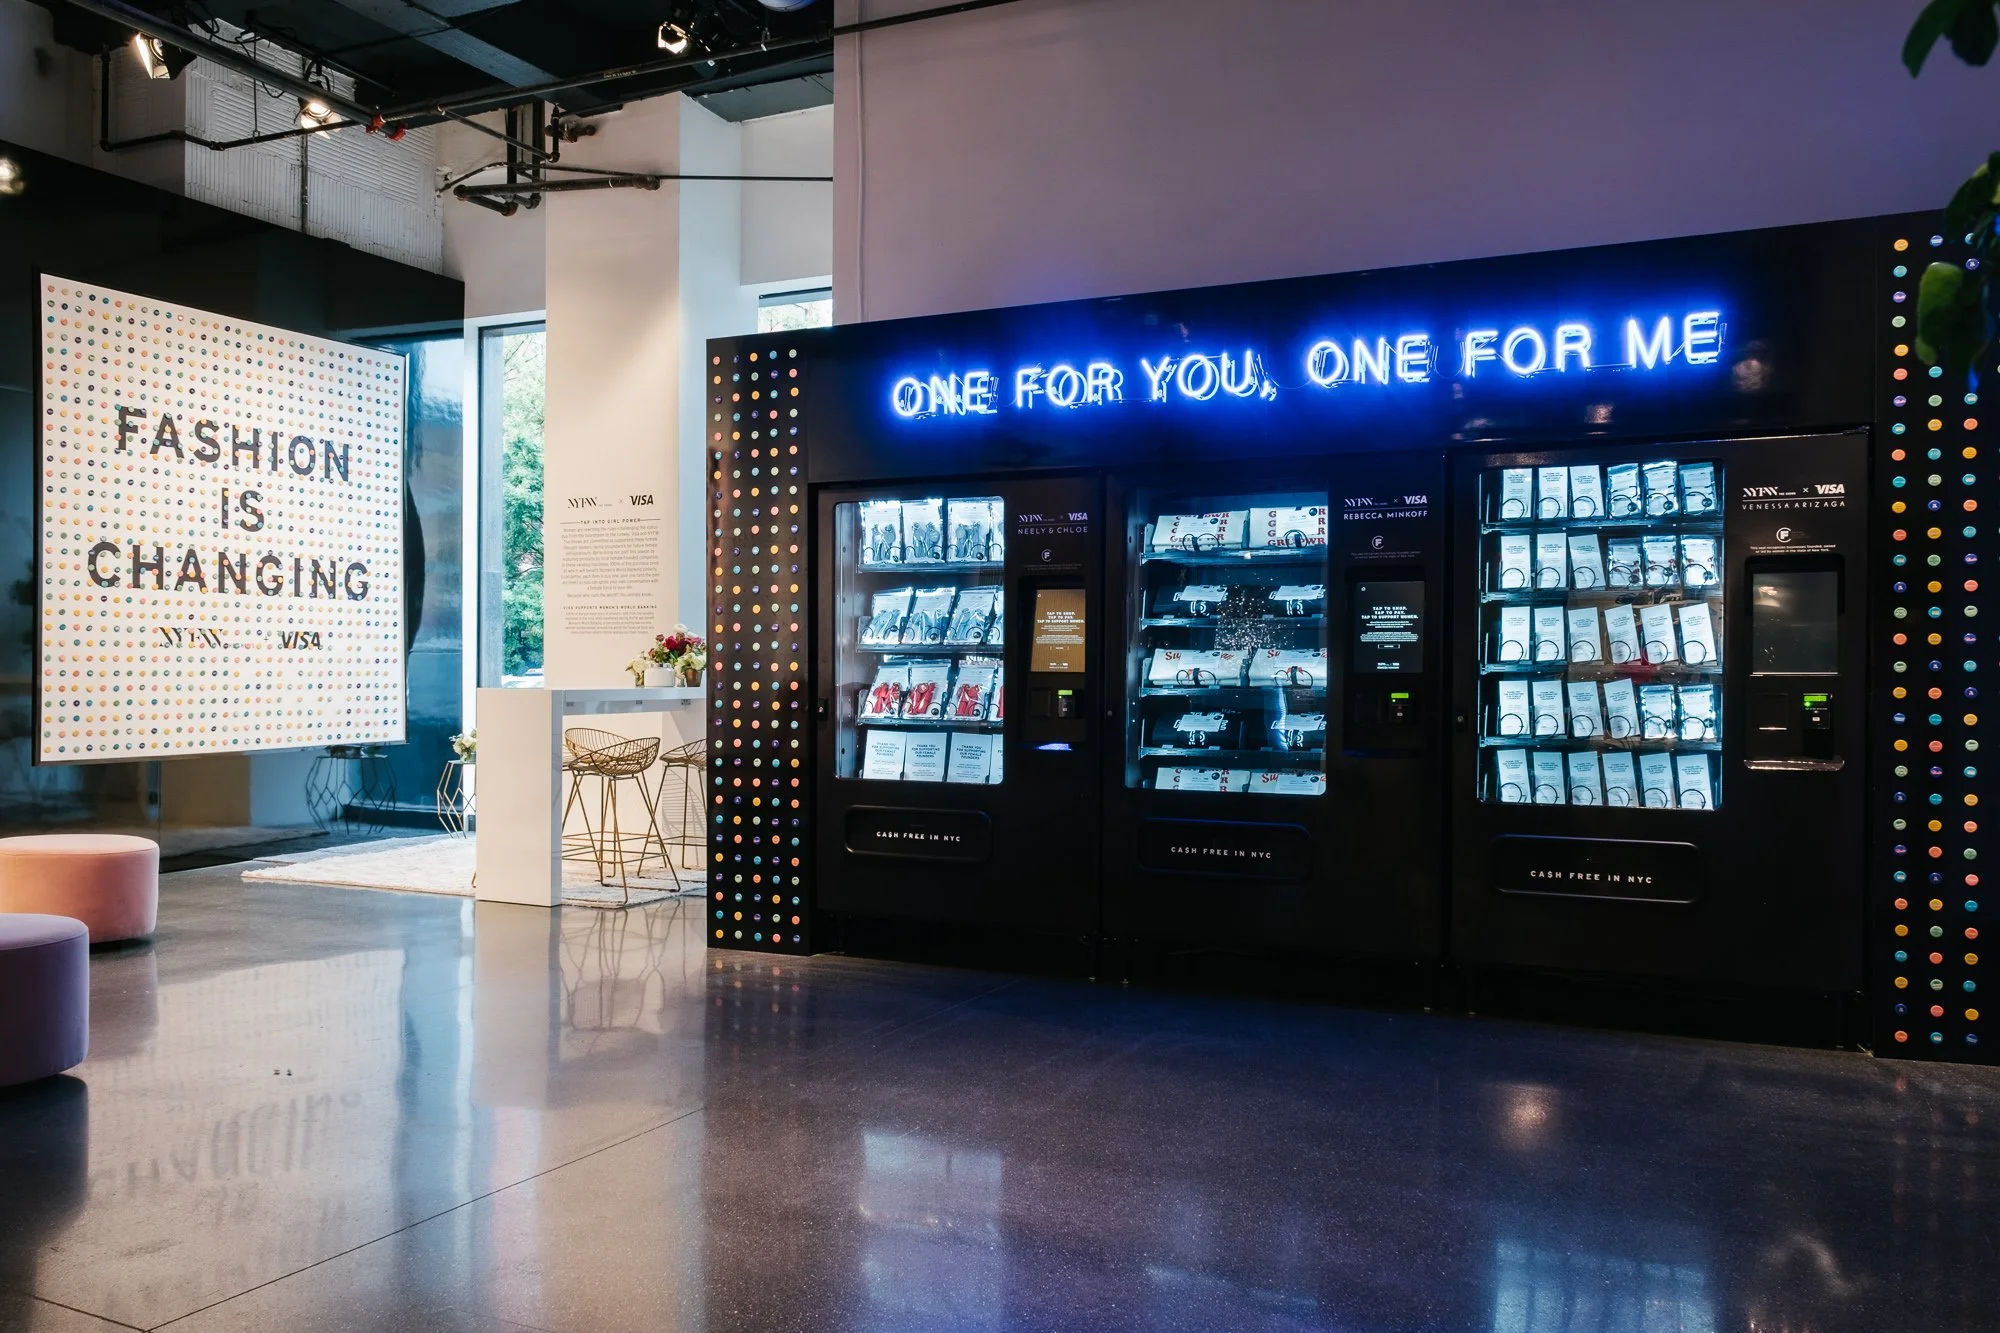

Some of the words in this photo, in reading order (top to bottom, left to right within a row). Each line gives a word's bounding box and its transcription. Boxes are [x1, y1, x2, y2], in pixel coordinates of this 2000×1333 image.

[893, 370, 990, 416] ONE
[1016, 363, 1116, 408] FOR
[1307, 335, 1429, 384] ONE
[1465, 325, 1591, 375] FOR
[1627, 312, 1720, 368] ME
[115, 406, 350, 482] FASHION
[630, 495, 653, 505] VISA
[1404, 495, 1427, 504] VISA
[1814, 484, 1845, 494] VISA
[221, 487, 265, 532] IS
[88, 541, 370, 601] CHANGING
[278, 630, 321, 649] VISA
